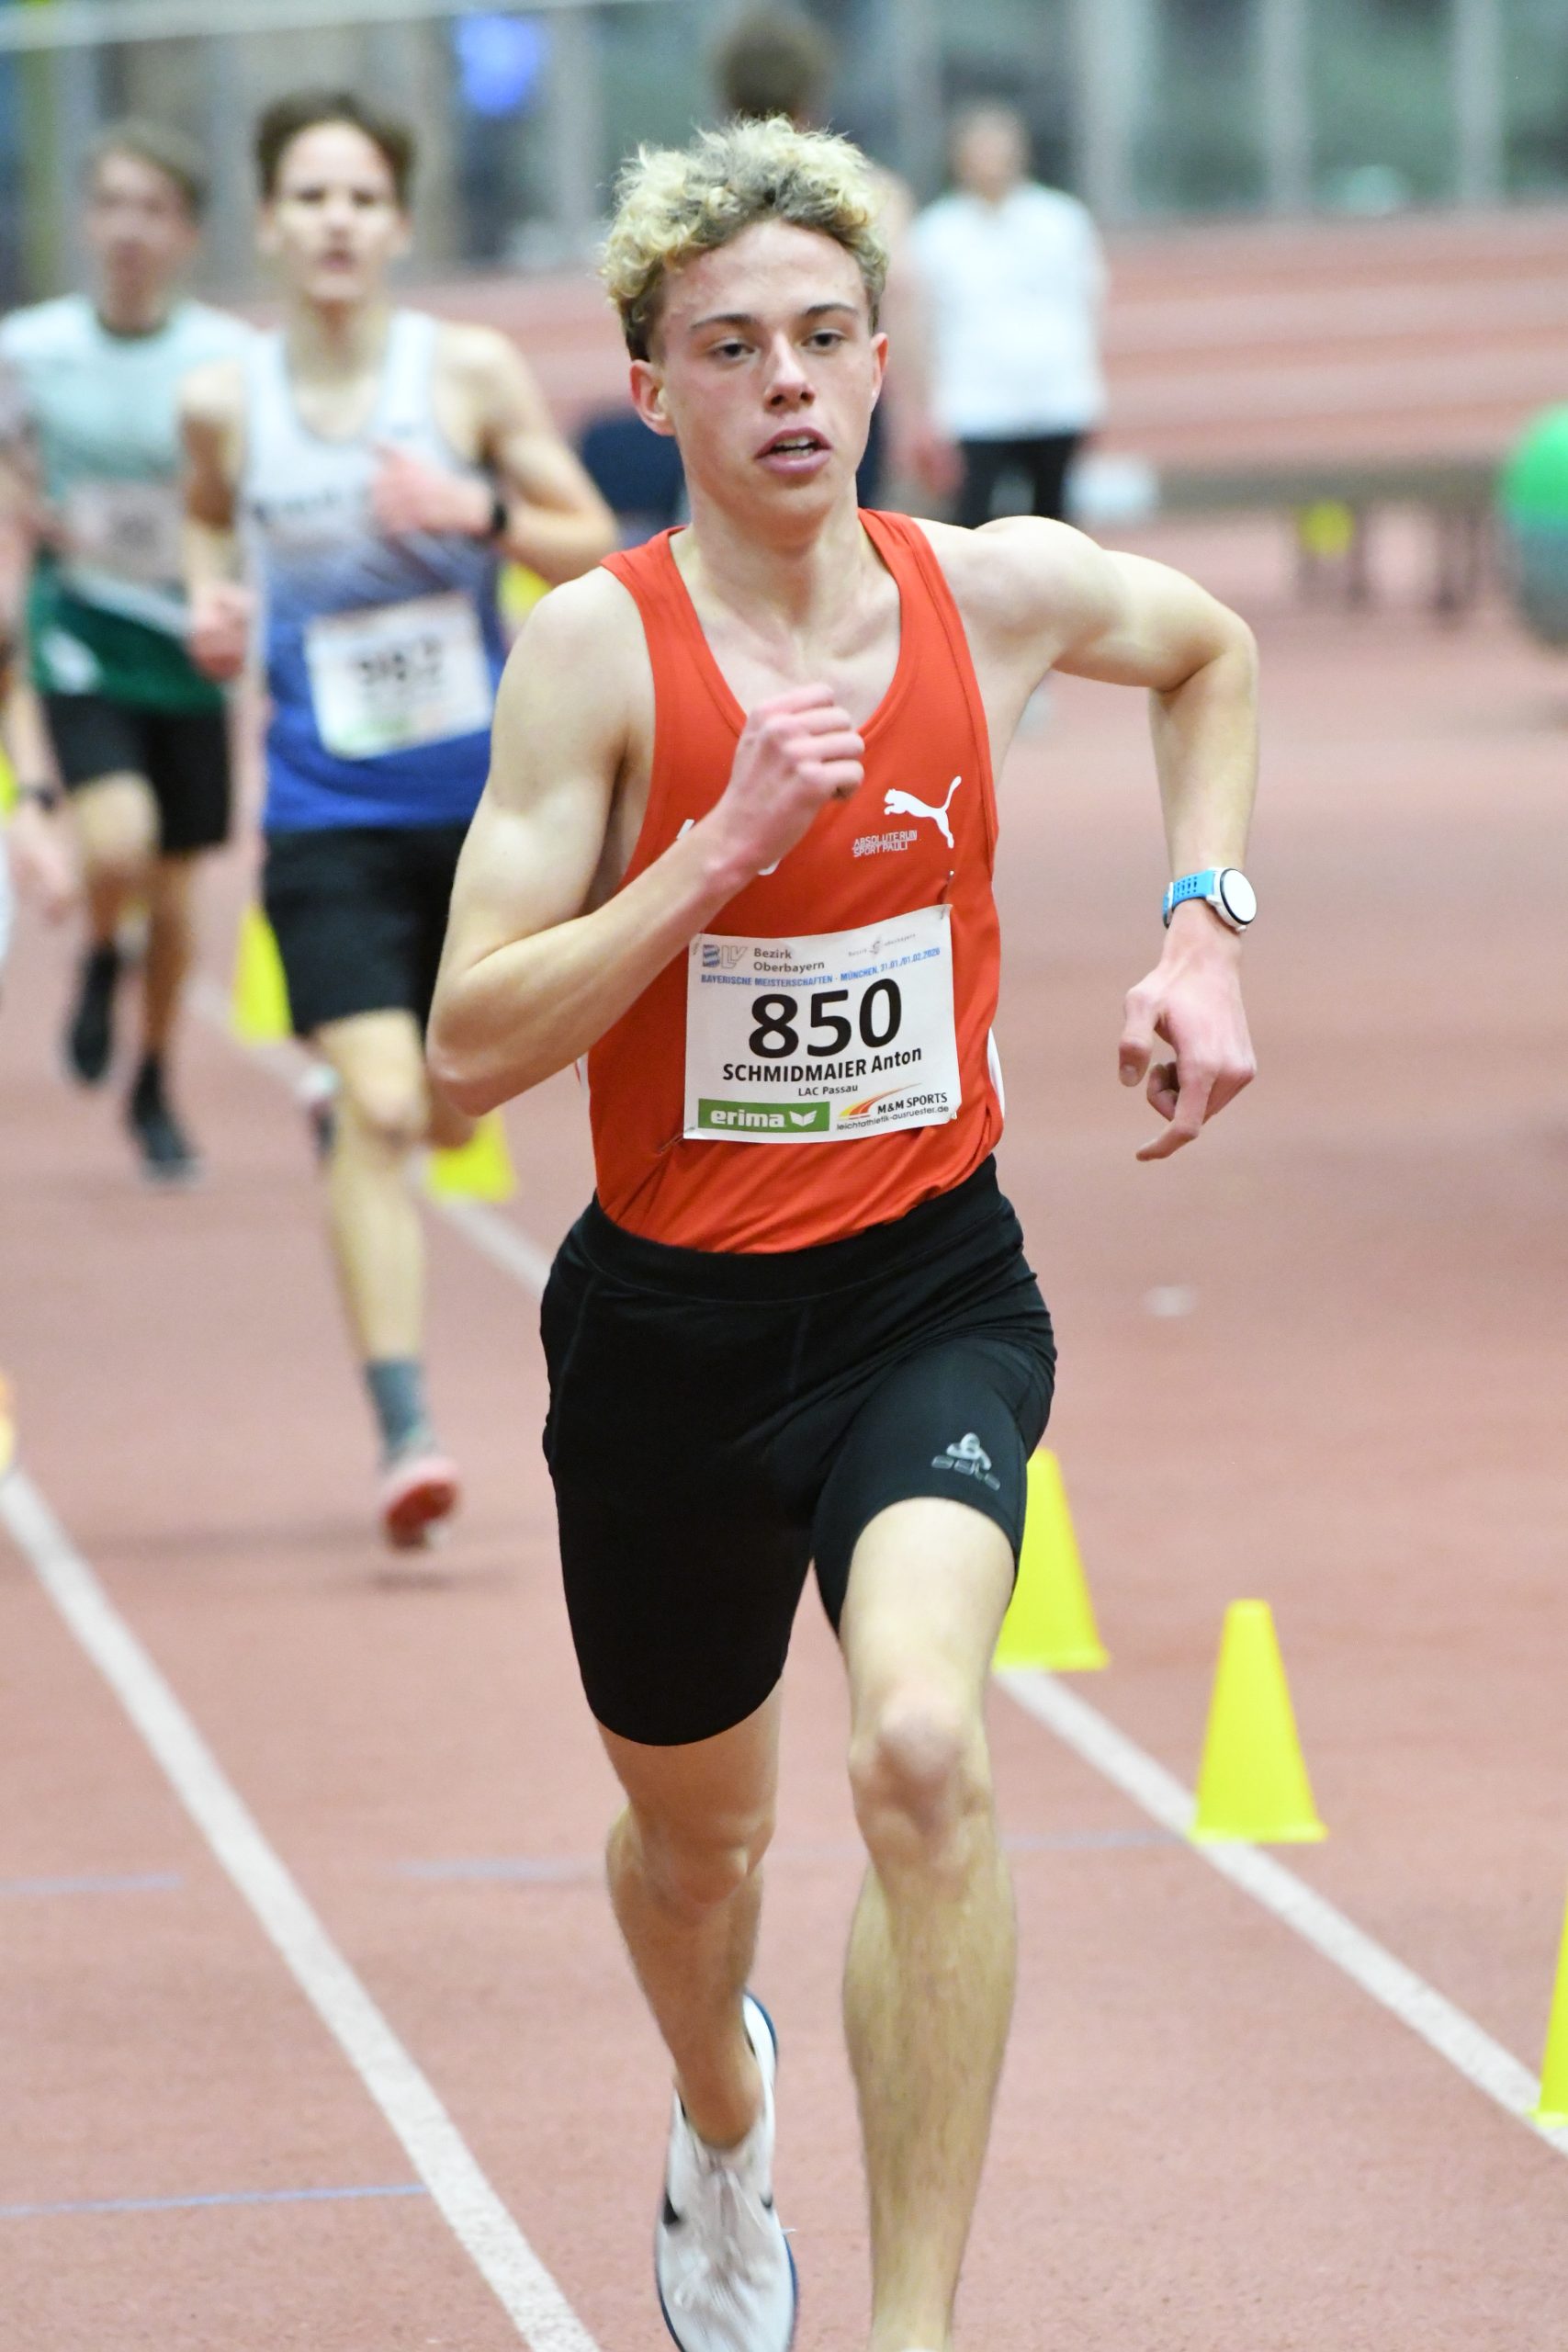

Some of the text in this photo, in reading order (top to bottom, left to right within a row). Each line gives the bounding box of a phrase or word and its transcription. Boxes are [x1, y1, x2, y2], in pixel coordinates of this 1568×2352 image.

[753, 947, 792, 959] Bezirk
[753, 961, 825, 974] Oberbayern
[701, 974, 751, 985] BAYERISCHE
[754, 975, 833, 987] MEISTERSCHAFTEN
[748, 977, 903, 1059] 850
[722, 1046, 922, 1082] SCHMIDMAIER Anton
[797, 1084, 859, 1097] LAC Passau
[877, 1091, 948, 1114] M&M SPORTS
[709, 1109, 785, 1128] erima
[836, 1104, 950, 1130] leichtathletik-ausruester.de
